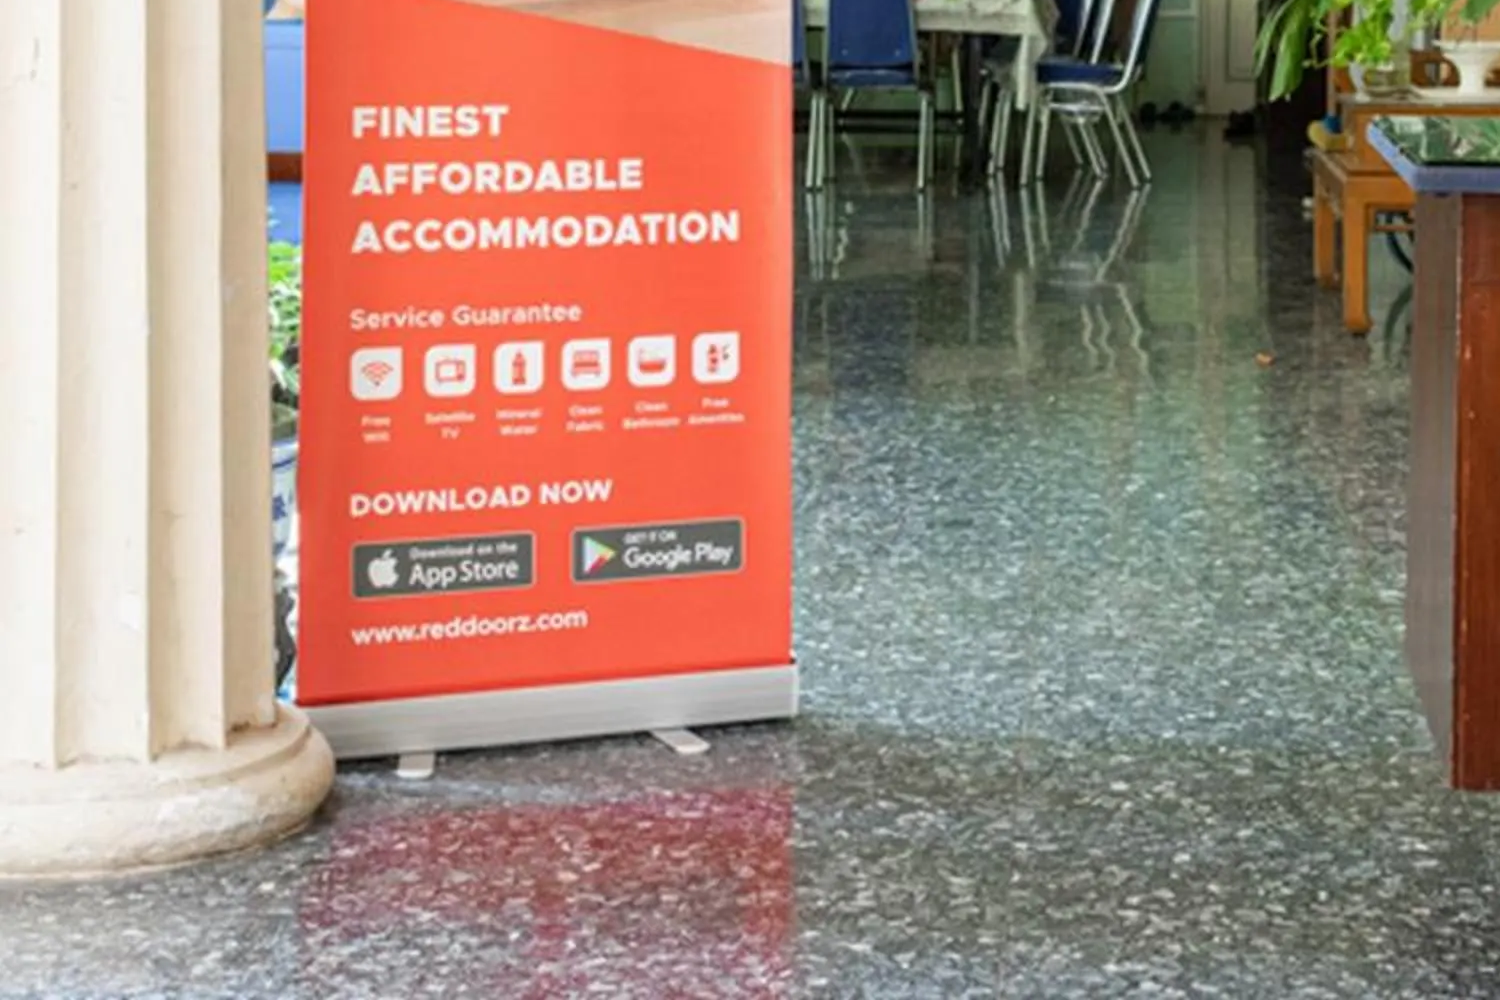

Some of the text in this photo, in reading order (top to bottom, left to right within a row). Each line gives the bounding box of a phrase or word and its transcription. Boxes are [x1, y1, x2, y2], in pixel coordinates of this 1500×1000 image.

[352, 105, 509, 138] FINEST
[352, 159, 643, 195] AFFORDABLE
[351, 211, 740, 254] ACCOMMODATION
[350, 304, 582, 330] Service Guarantee
[350, 479, 613, 518] DOWNLOAD NOW
[623, 541, 734, 571] Google Play
[408, 559, 519, 589] App Store
[351, 609, 588, 646] www.reddoorz.com
